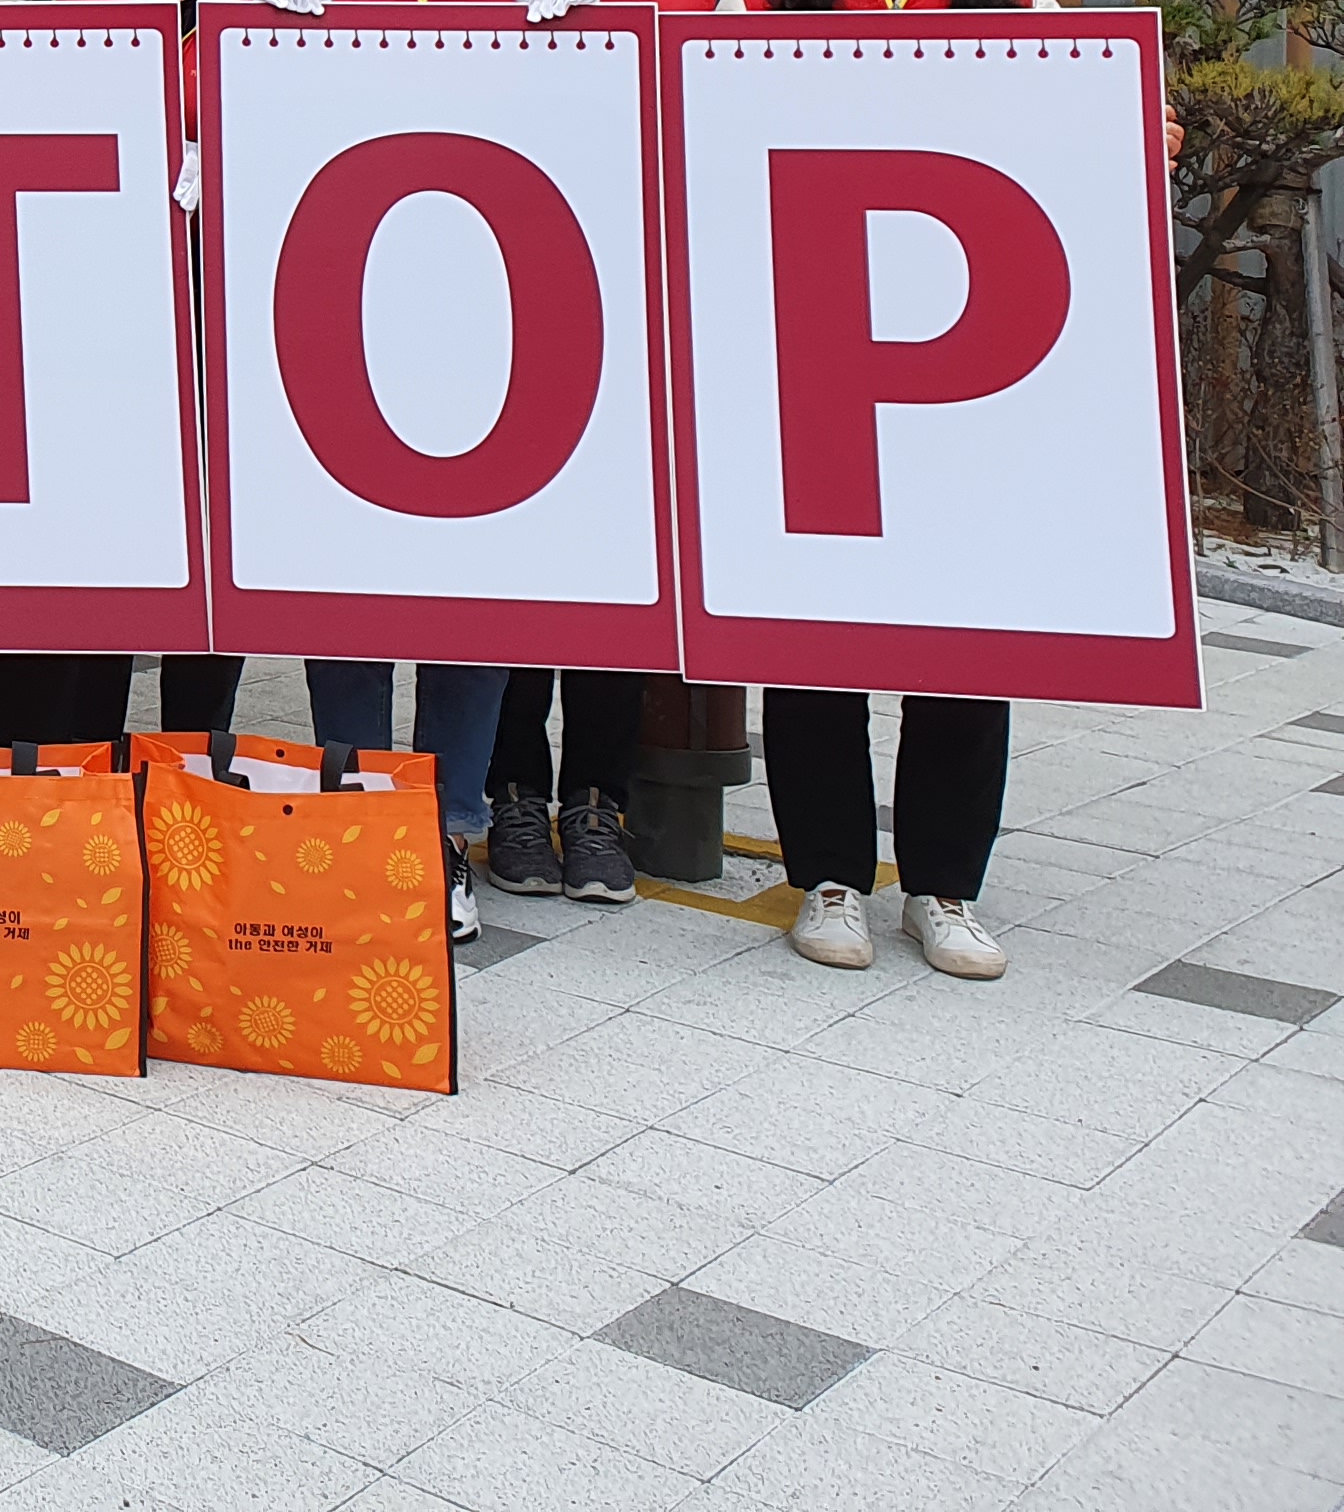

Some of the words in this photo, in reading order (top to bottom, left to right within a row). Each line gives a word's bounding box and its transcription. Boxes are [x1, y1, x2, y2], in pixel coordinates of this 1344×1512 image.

[3, 926, 30, 941] 거제
[234, 922, 277, 937] 아동과
[281, 924, 323, 939] 여성이
[228, 938, 253, 951] the
[257, 938, 300, 953] 안전한
[305, 940, 333, 954] 거제
